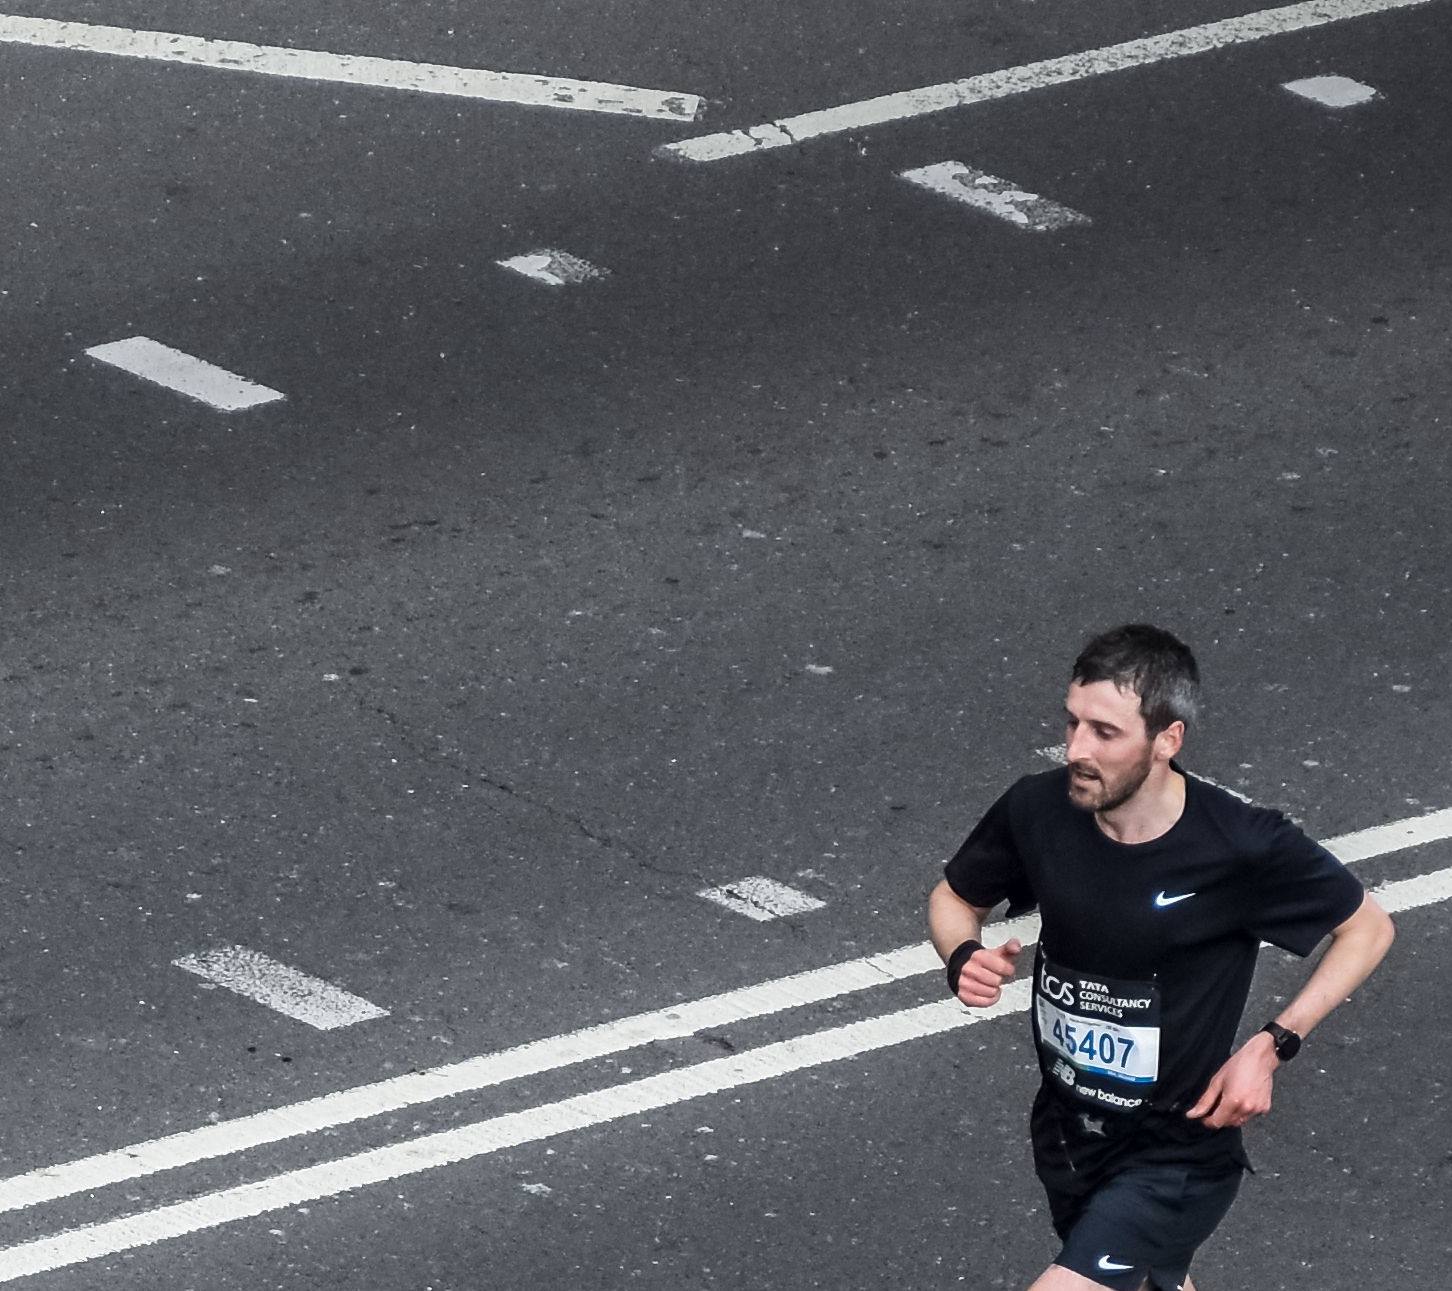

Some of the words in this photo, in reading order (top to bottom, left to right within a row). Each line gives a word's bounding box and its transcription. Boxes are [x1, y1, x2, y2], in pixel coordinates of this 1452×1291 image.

[1079, 980, 1109, 994] TATA
[1079, 990, 1152, 1008] CONSULTANCY
[1079, 1001, 1123, 1018] SERVICES
[1053, 1018, 1135, 1068] 45407
[1076, 1084, 1097, 1096] new
[1097, 1089, 1143, 1107] balance
